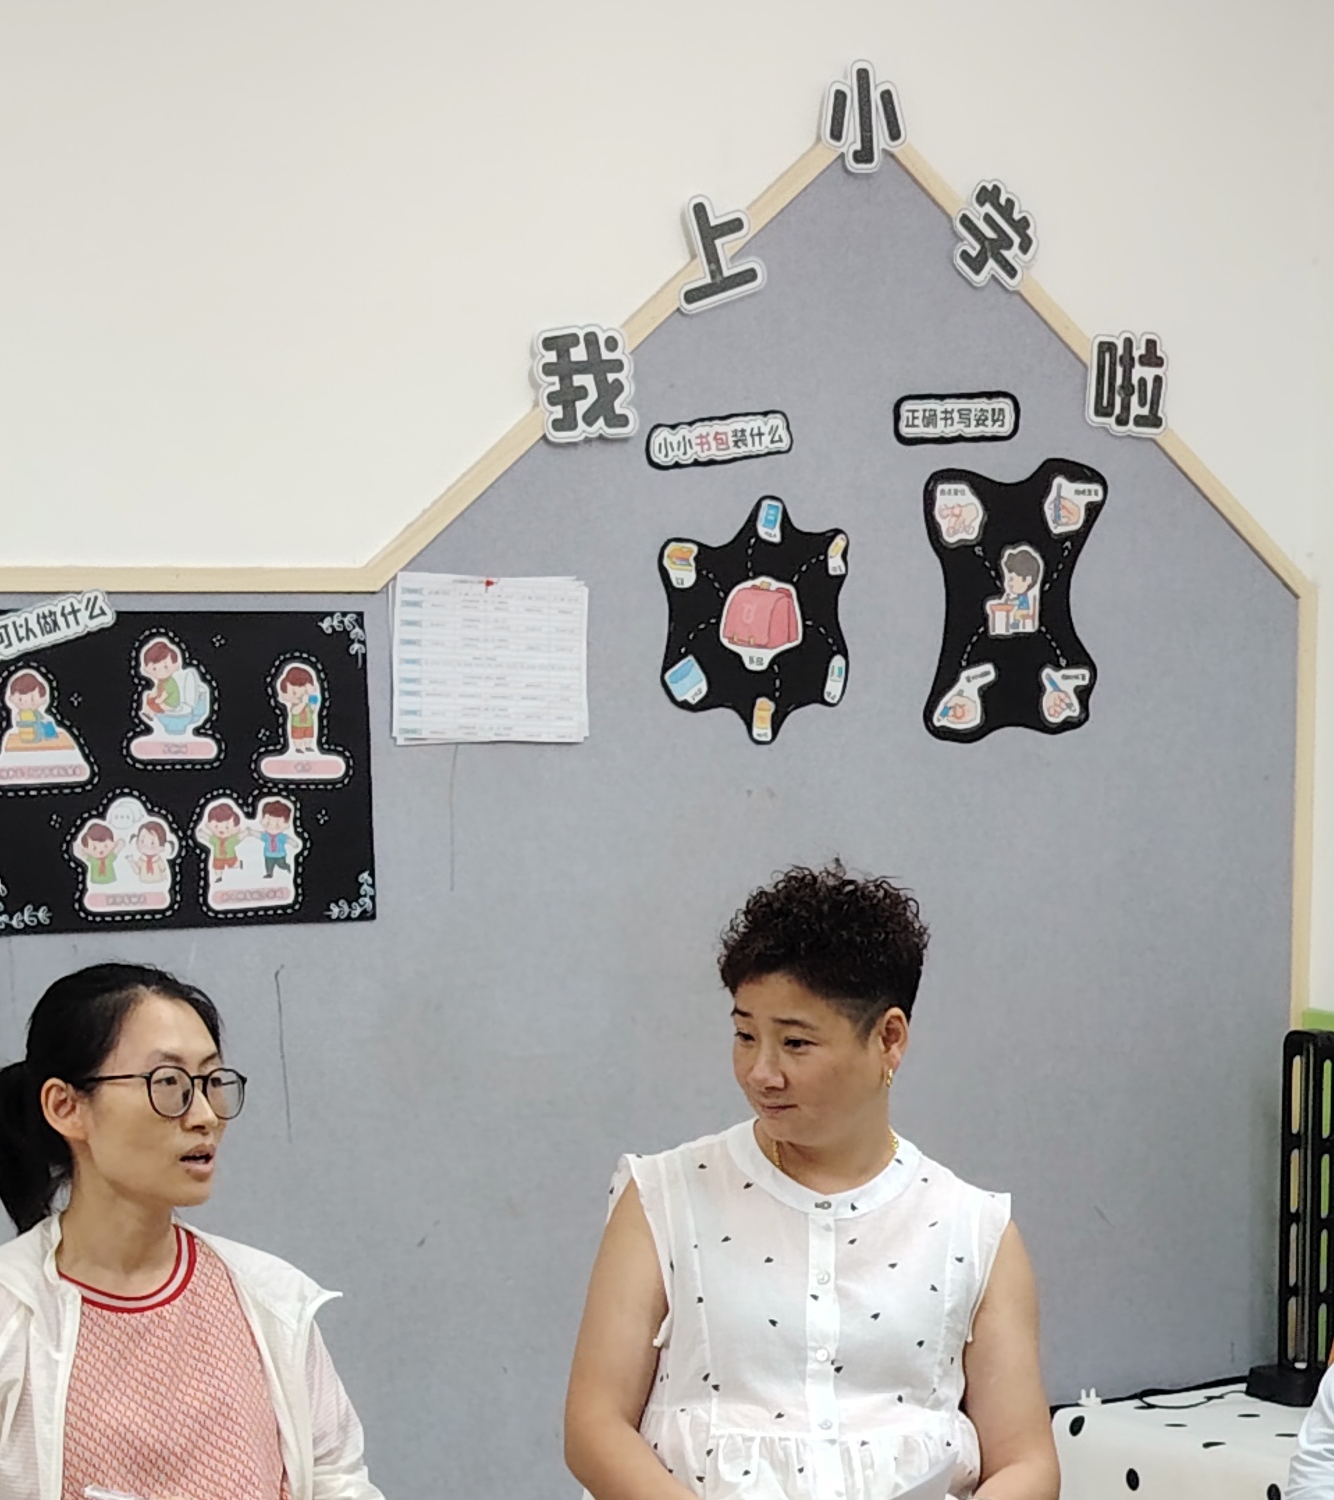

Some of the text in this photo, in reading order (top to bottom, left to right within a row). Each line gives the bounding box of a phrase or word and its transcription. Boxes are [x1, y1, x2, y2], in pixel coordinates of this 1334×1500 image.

[542, 68, 1163, 429] 我上小学啦
[905, 407, 1006, 429] 正确书写姿势
[658, 421, 783, 458] 小小书包装什么
